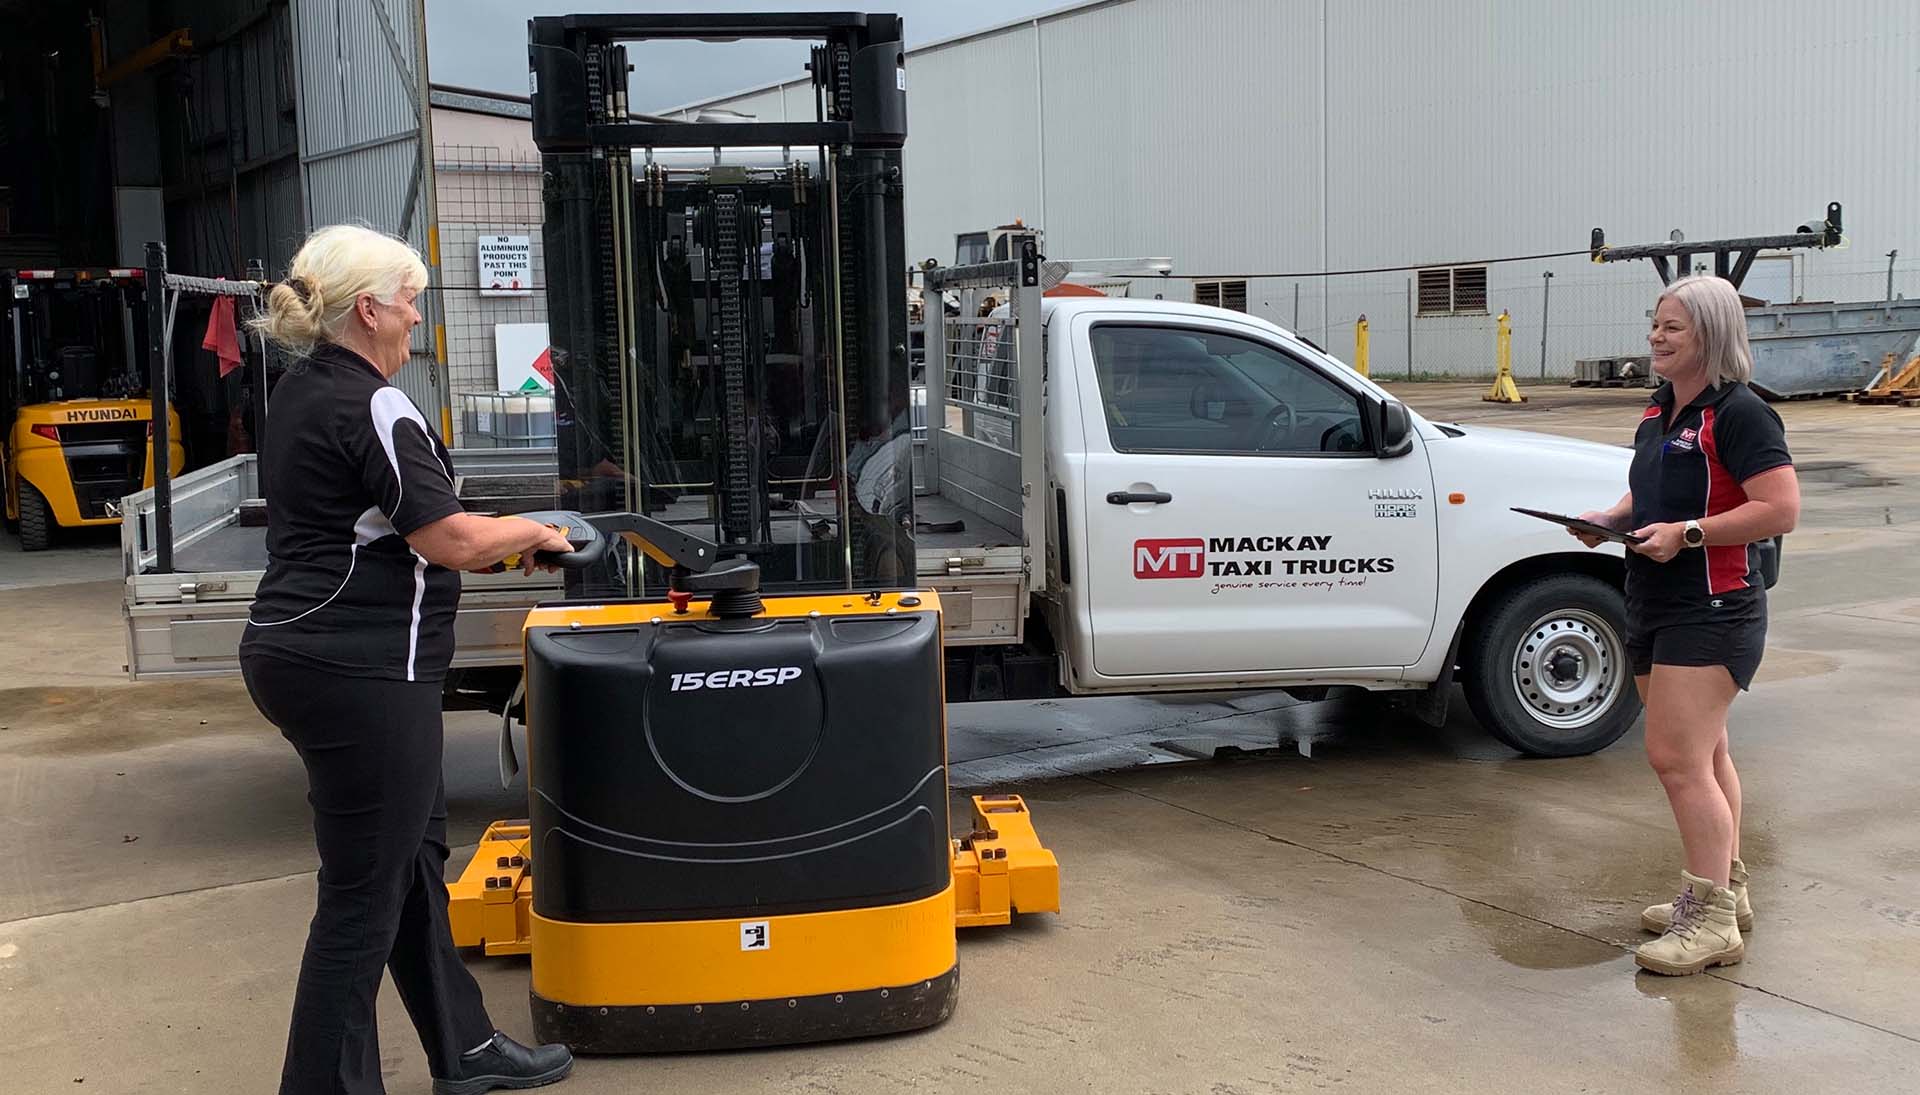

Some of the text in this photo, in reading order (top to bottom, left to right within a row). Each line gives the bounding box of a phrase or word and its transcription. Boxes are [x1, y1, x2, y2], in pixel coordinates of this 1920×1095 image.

[508, 261, 528, 269] THIS
[67, 407, 137, 422] HYUNDAI
[1368, 488, 1423, 500] HILUX
[1374, 503, 1417, 511] WORK
[1374, 510, 1417, 518] MATE
[1209, 535, 1332, 553] MACKAY
[1136, 546, 1204, 572] MTT
[1208, 558, 1394, 577] TAXI TRUCKS
[1211, 576, 1367, 594] genuine service every time!
[670, 666, 802, 692] 15ERSP
